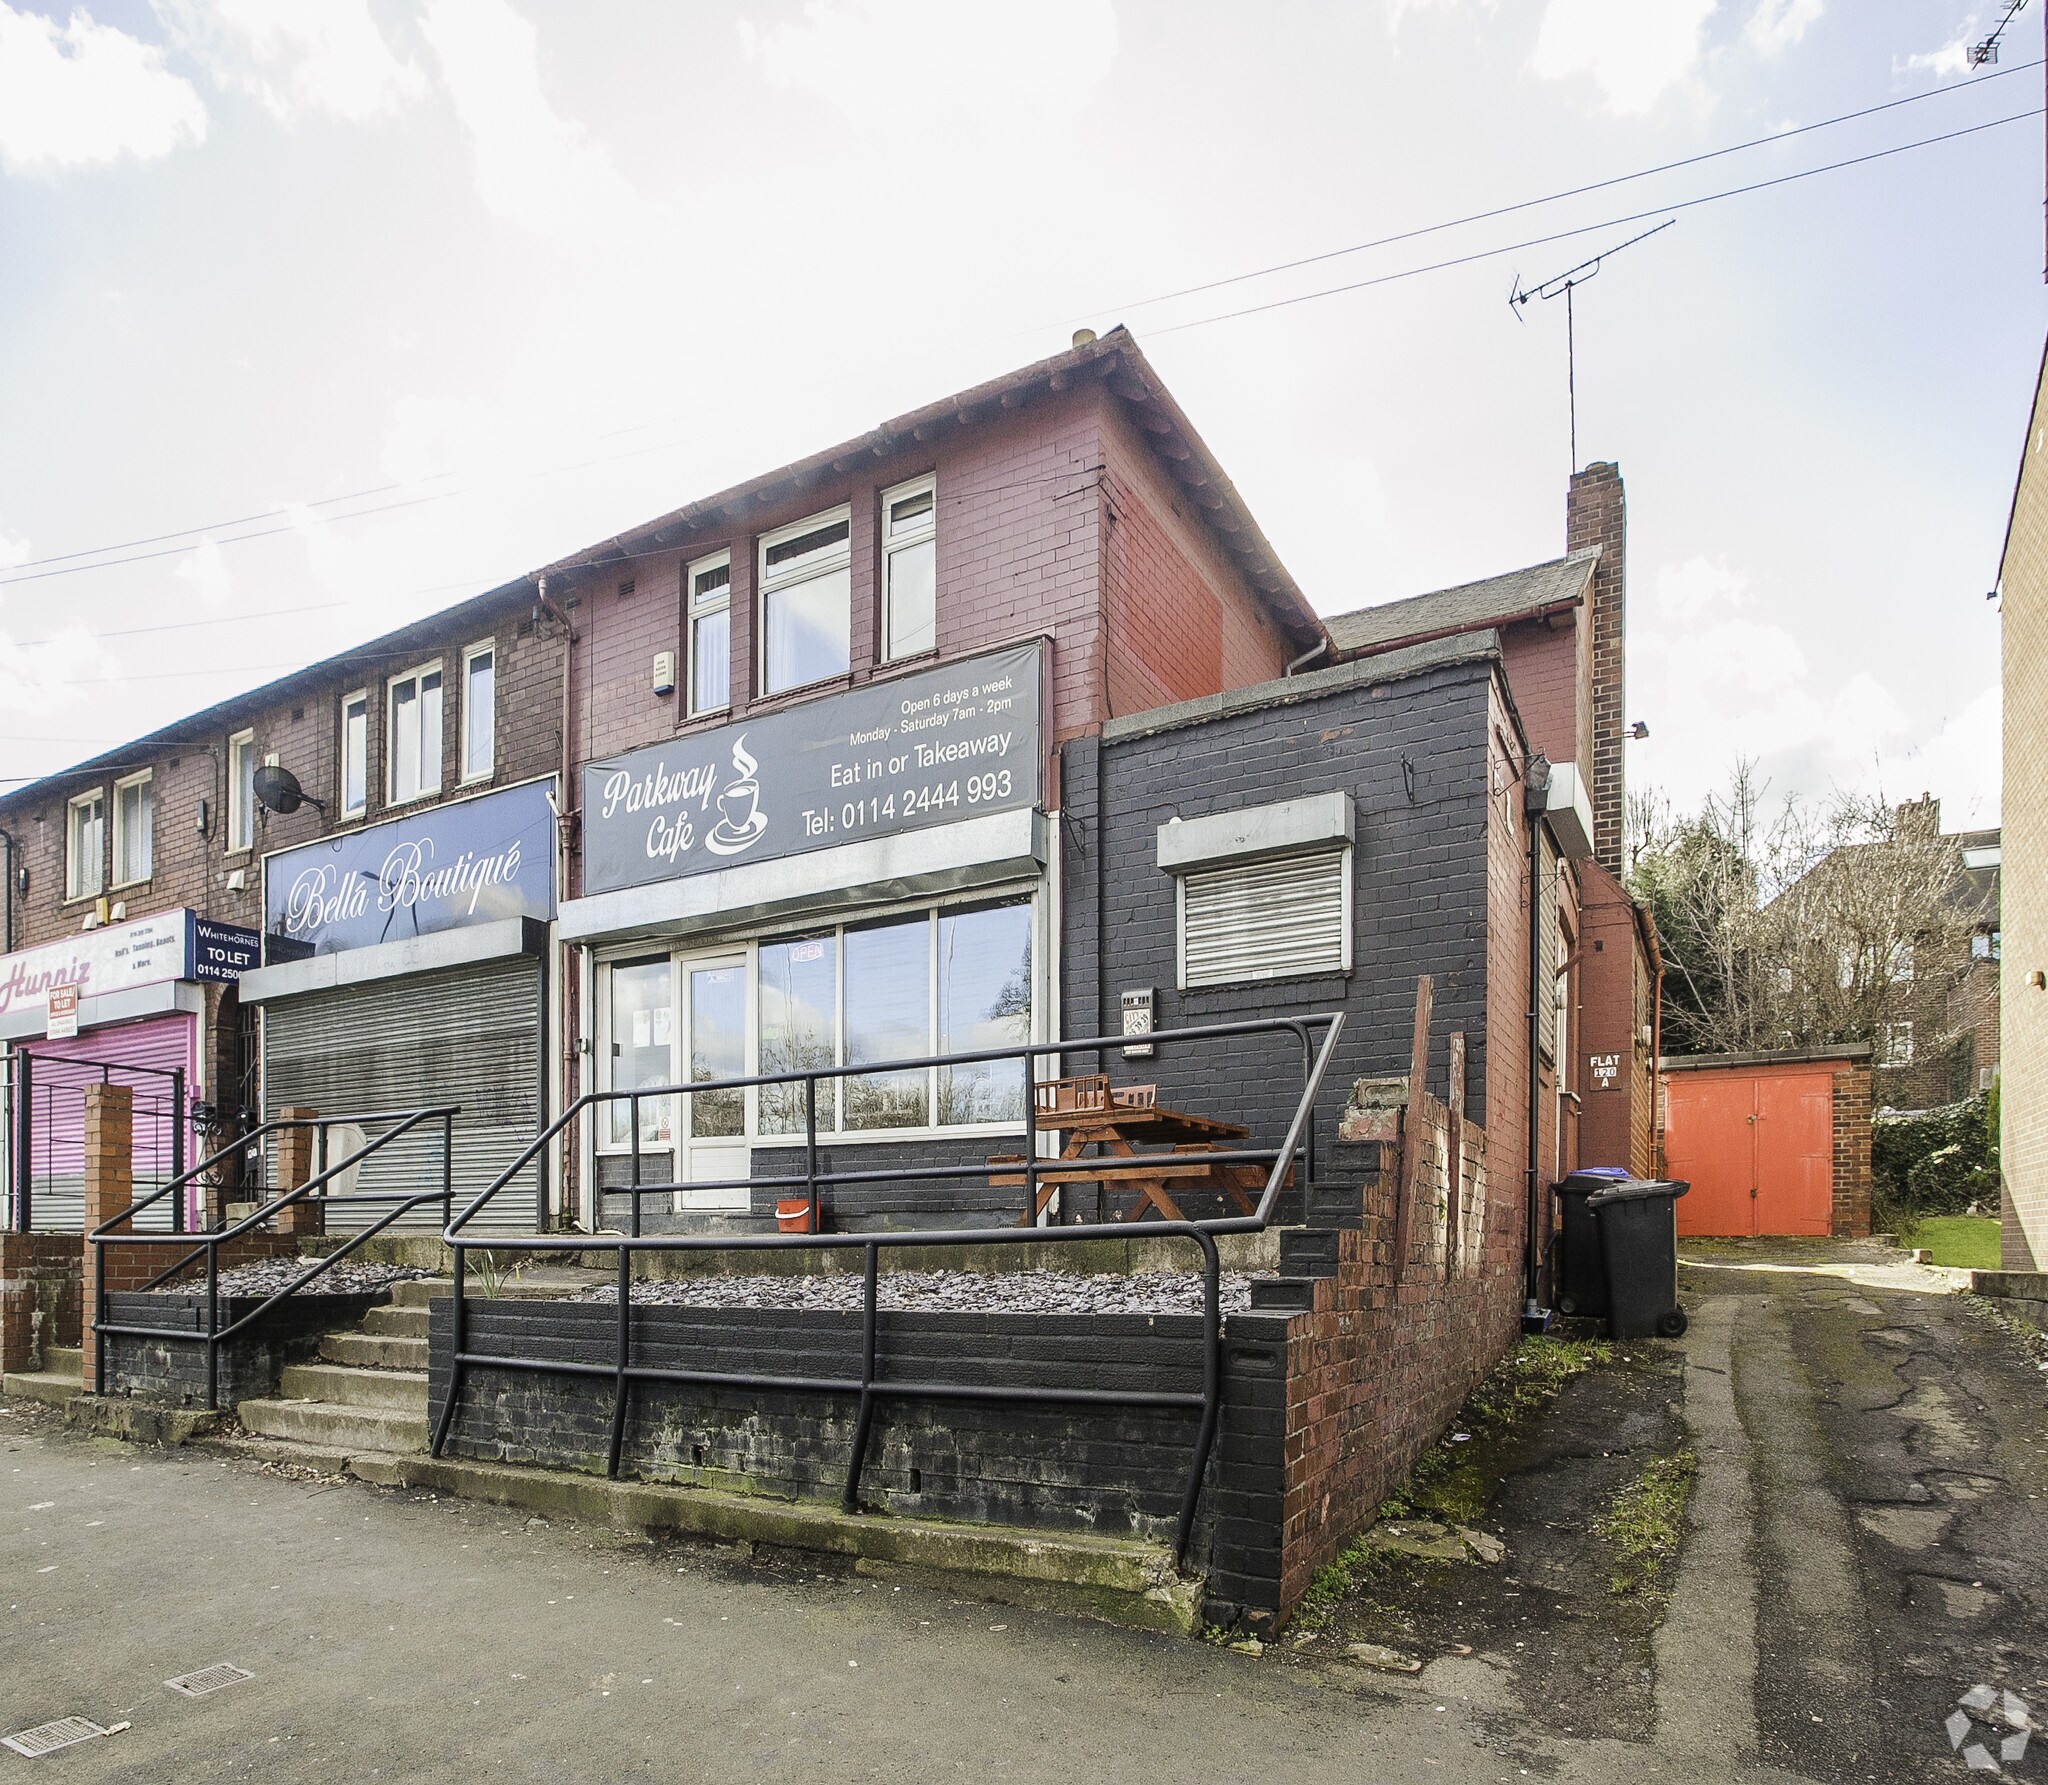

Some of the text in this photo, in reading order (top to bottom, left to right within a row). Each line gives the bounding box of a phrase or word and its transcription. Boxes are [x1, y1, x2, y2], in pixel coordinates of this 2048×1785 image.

[901, 675, 1013, 715] Open 6 days a week
[850, 727, 891, 746] Monday
[900, 713, 949, 733] Saturday
[952, 706, 976, 721] 7am
[987, 698, 1012, 715] 2pm
[831, 732, 1012, 788] Eat in or Takeaway
[602, 761, 718, 819] Parkway
[802, 769, 1012, 837] Tel: 0114 2444 993
[646, 811, 695, 863] Cafe
[286, 837, 521, 933] Bellá Boutiqué
[207, 947, 250, 966] TO LET
[794, 945, 821, 960] OPEN
[197, 964, 220, 976] 0114
[0, 956, 91, 1014] Hunniz
[50, 990, 60, 1000] FOR
[53, 999, 71, 1010] TO LET
[1590, 1055, 1620, 1067] FLAT
[1596, 1068, 1615, 1077] 120
[1601, 1077, 1609, 1087] A
